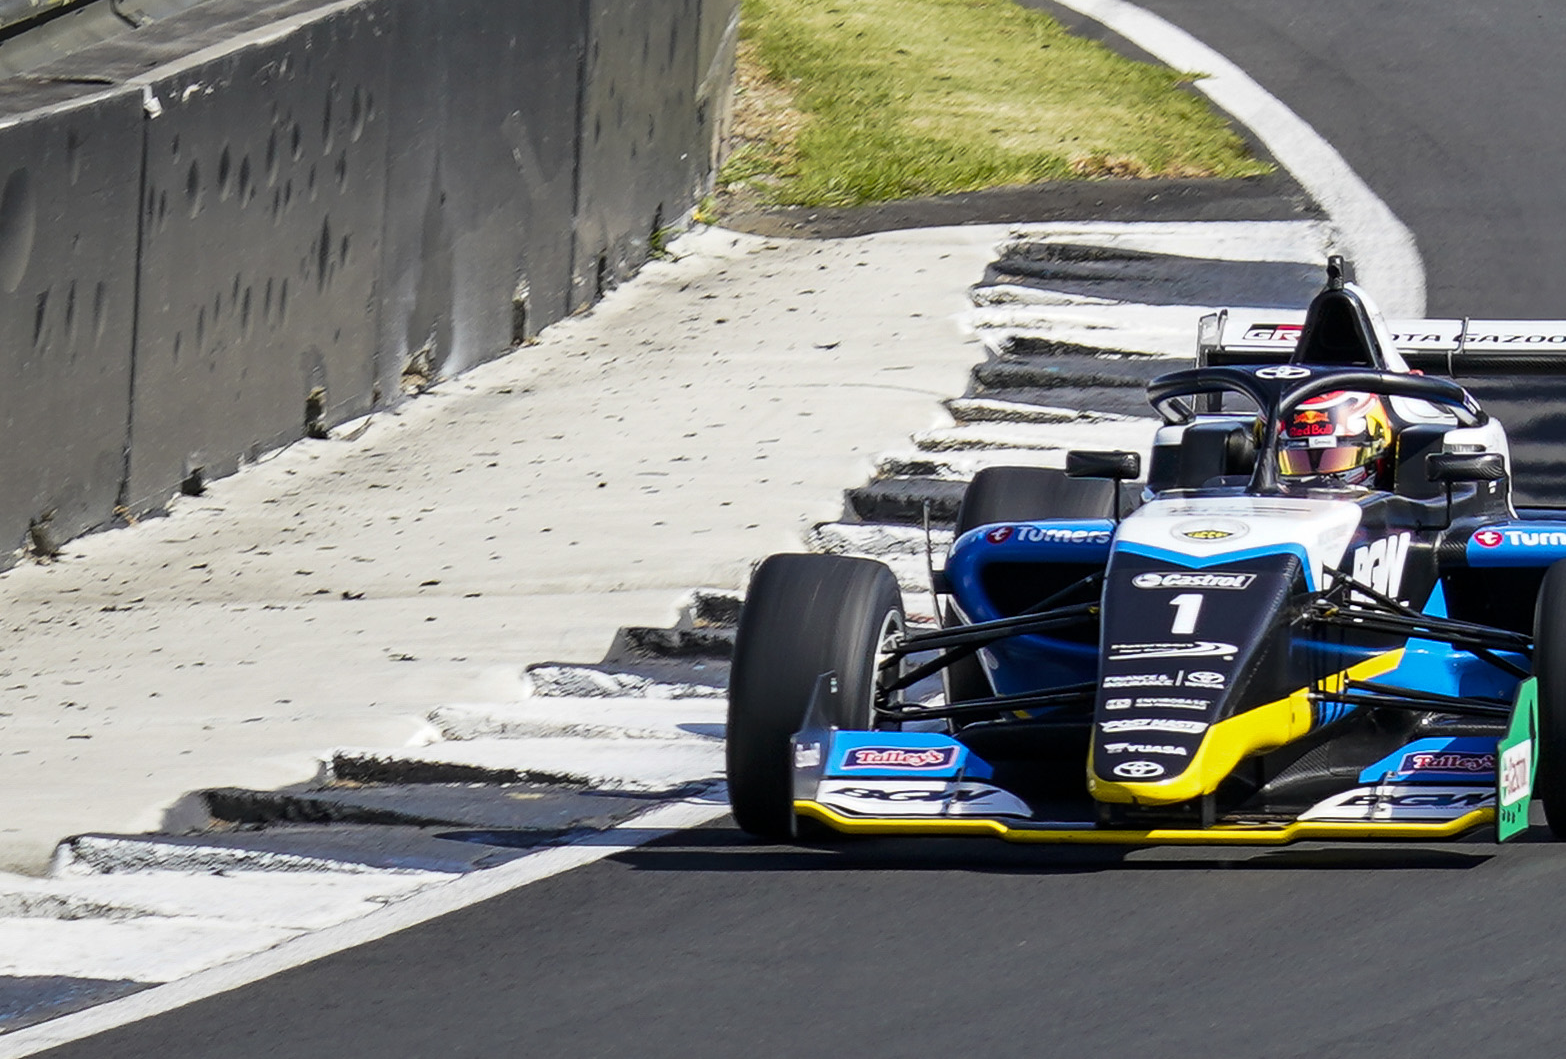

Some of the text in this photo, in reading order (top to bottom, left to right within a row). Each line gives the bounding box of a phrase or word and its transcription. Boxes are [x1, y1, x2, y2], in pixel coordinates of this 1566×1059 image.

[1242, 323, 1304, 340] GR
[1311, 423, 1334, 436] Bull
[1017, 526, 1111, 544] Turners
[1161, 574, 1246, 589] Castrol
[1169, 593, 1204, 635] 1
[855, 750, 945, 767] Talley's
[1127, 744, 1187, 756] YUASA
